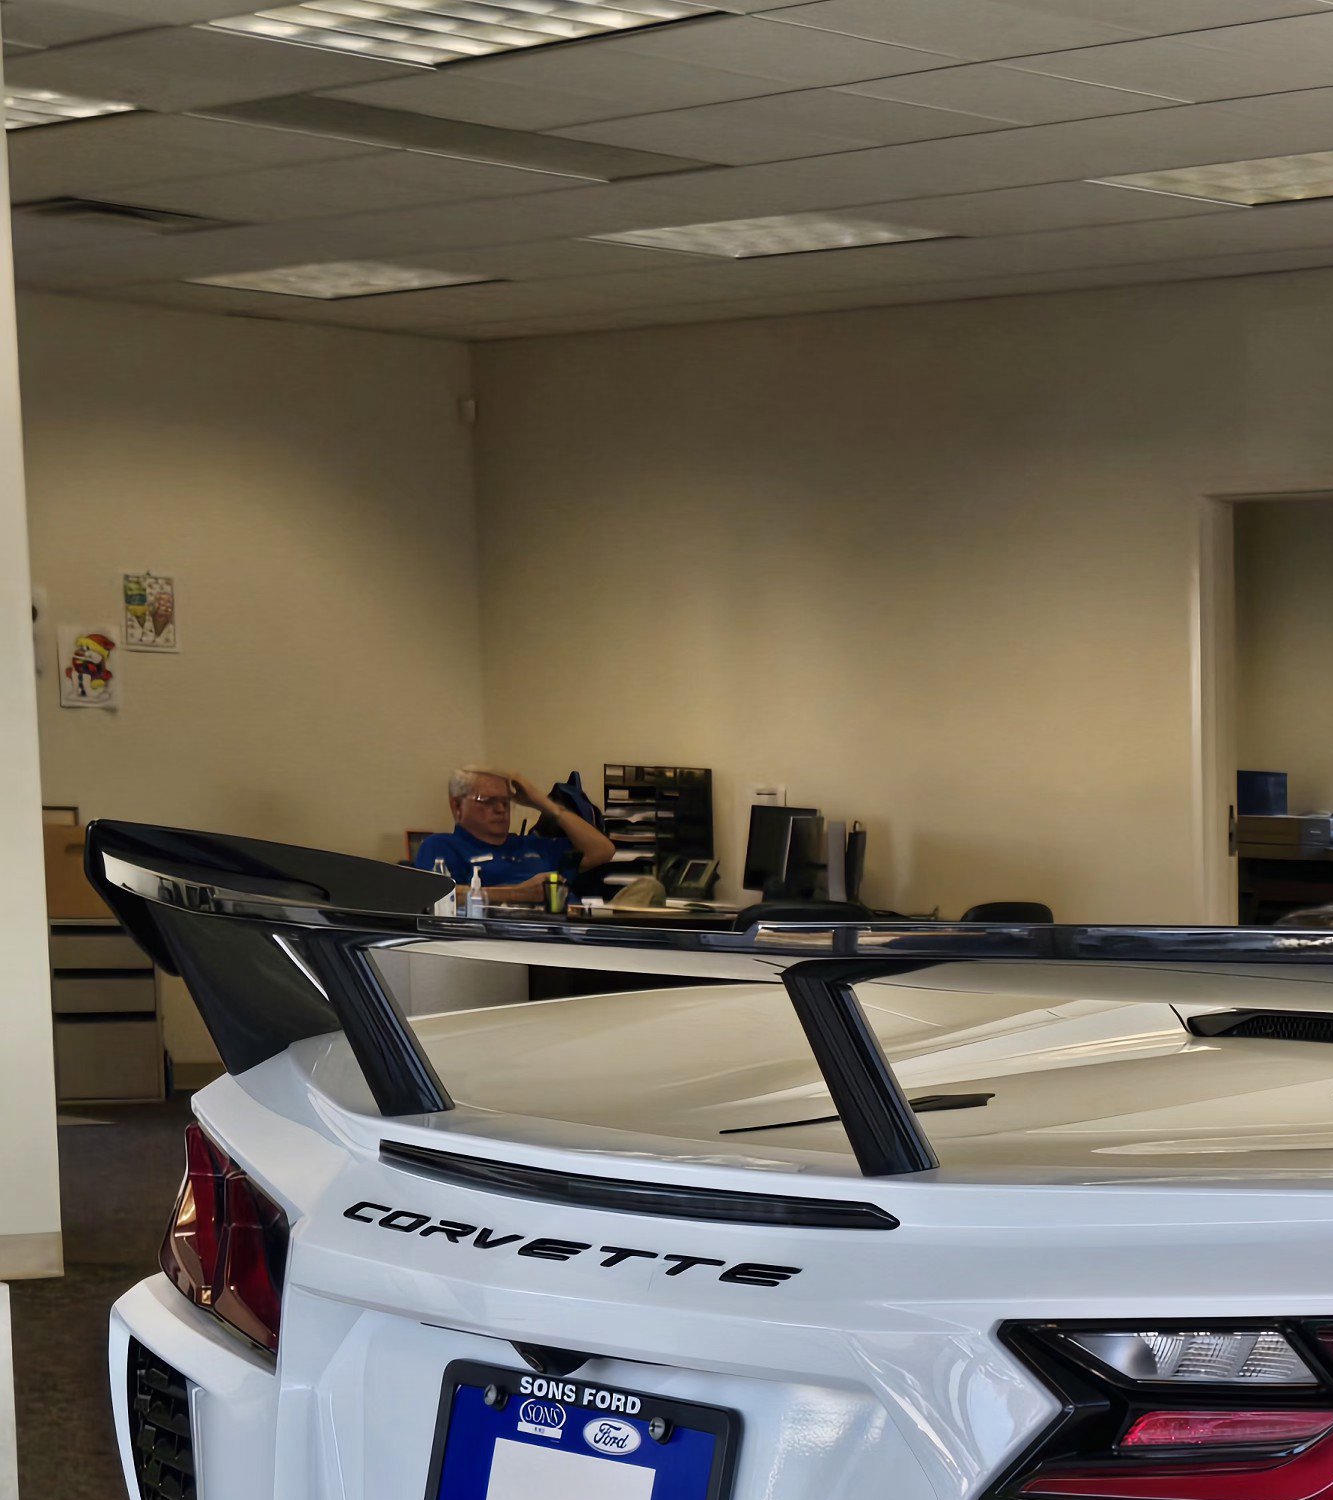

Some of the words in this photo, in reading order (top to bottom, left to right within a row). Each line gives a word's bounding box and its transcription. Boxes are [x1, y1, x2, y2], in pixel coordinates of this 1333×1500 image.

[343, 1201, 803, 1288] CORVETTE
[520, 1376, 576, 1402] SONS
[582, 1388, 641, 1414] FORD
[525, 1404, 560, 1426] SONS
[593, 1422, 630, 1449] Ford
